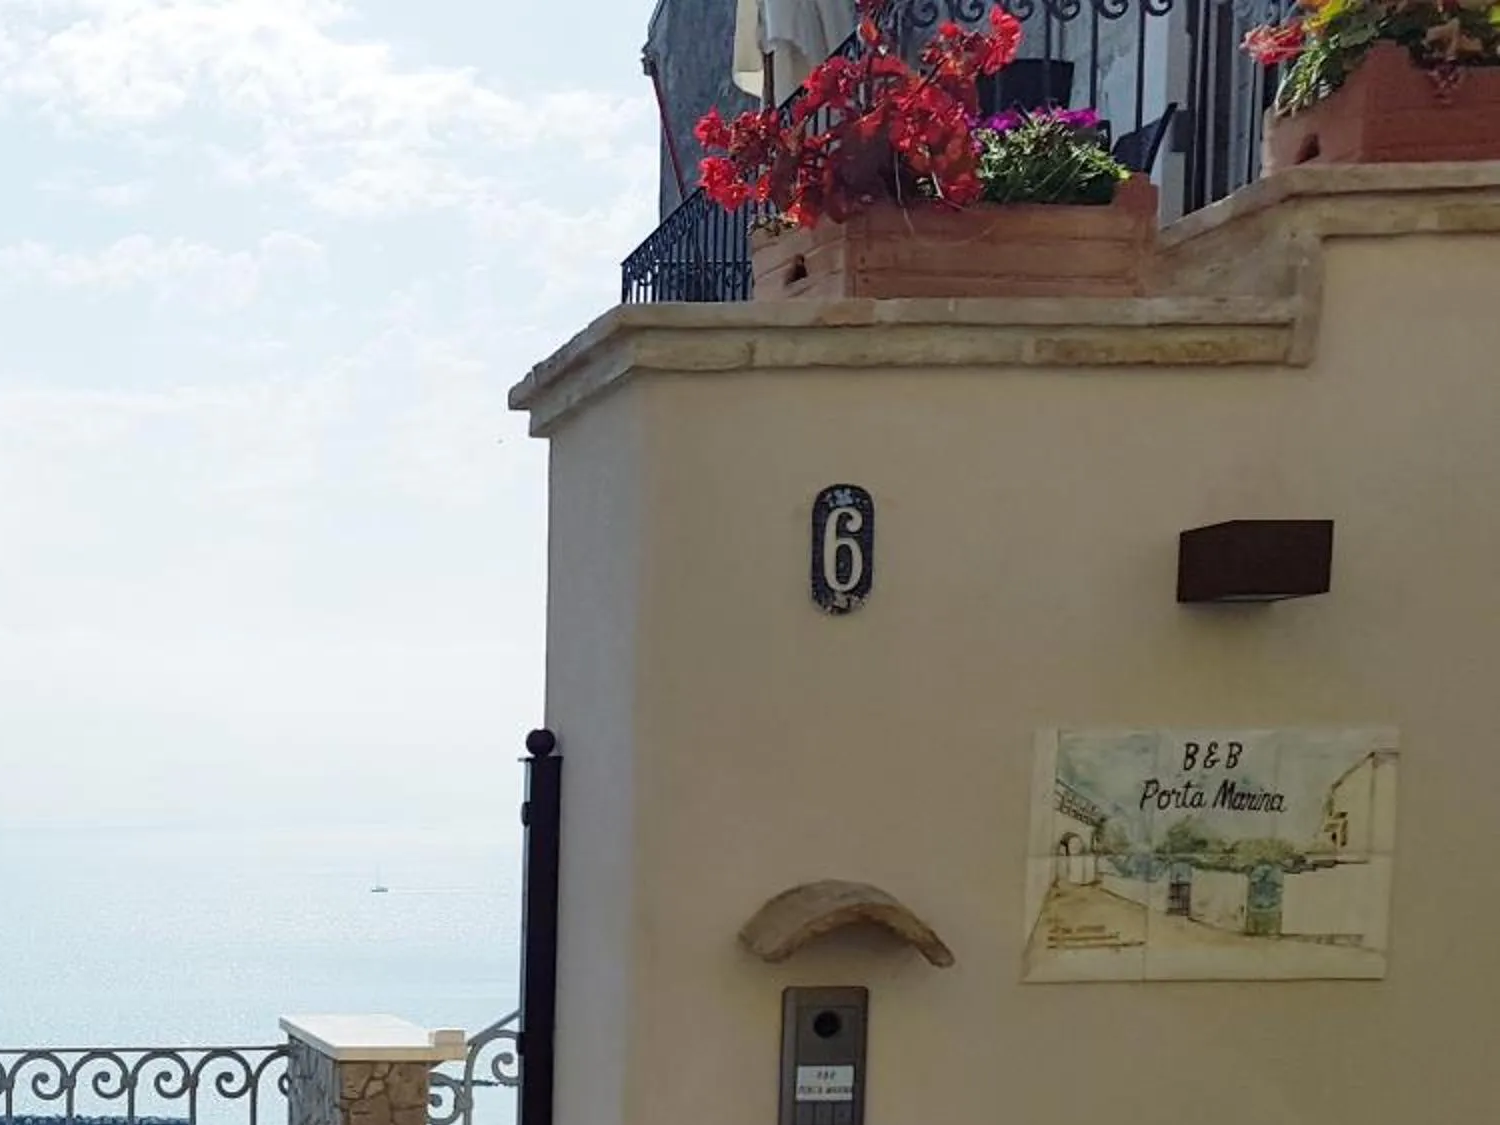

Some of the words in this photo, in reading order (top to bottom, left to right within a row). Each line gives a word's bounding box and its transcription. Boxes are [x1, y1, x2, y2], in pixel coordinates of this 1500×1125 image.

[823, 506, 863, 593] 6
[1140, 778, 1207, 811] Porta
[1211, 778, 1287, 813] Marina
